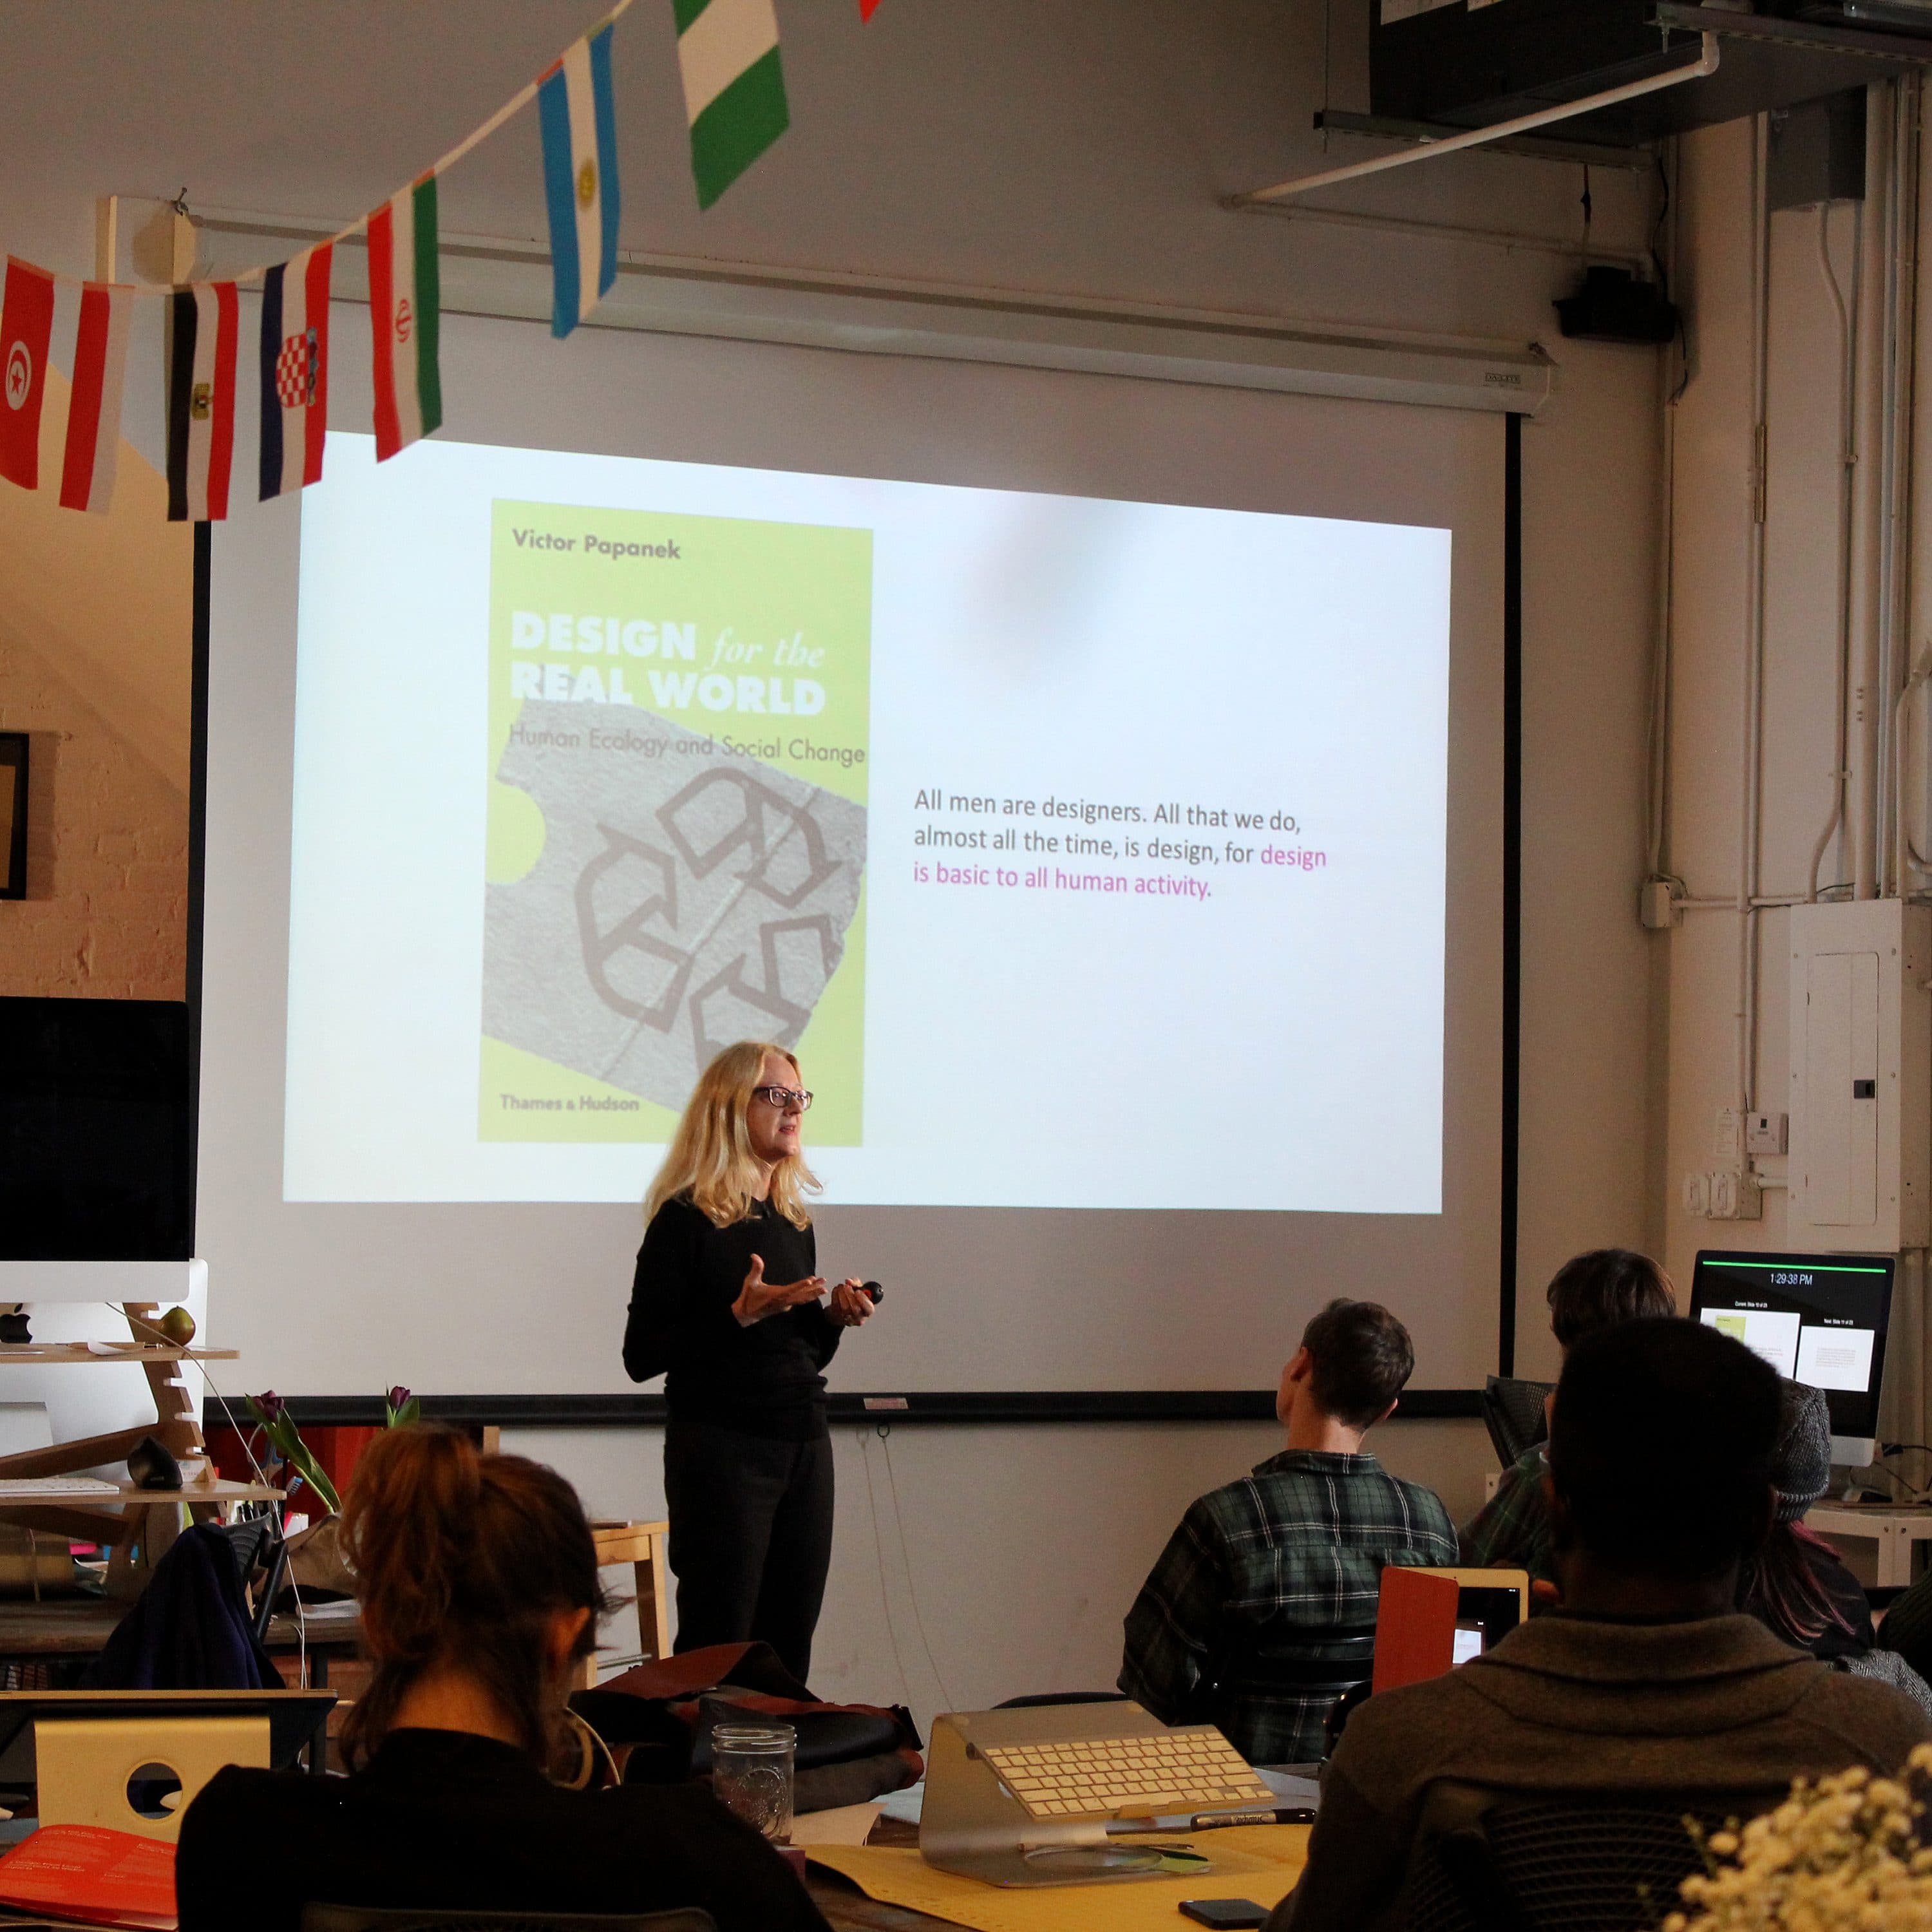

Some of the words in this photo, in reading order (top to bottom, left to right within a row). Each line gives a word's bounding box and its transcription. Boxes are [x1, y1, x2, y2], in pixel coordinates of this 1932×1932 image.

[513, 529, 576, 552] Victor
[585, 535, 681, 560] Papanek
[511, 611, 696, 661] DESIGN
[703, 626, 763, 671] for
[773, 632, 825, 667] the
[511, 661, 633, 705] REAL
[647, 671, 826, 715] WORLD
[509, 723, 580, 748] Human
[589, 728, 669, 757] Ecology
[676, 734, 713, 756] and
[723, 736, 781, 759] Social
[790, 739, 866, 768] Change
[914, 789, 942, 811] All
[949, 795, 996, 813] men
[1002, 798, 1036, 817] are
[1042, 796, 1147, 824] designers.
[1153, 803, 1179, 824] All
[1187, 804, 1228, 828] that
[1234, 813, 1264, 829] we
[1269, 810, 1301, 835] do,
[914, 824, 987, 849] almost
[992, 829, 1016, 850] all
[1023, 831, 1058, 853] the
[1065, 834, 1119, 860] time,
[1124, 837, 1140, 857] is
[1147, 837, 1219, 865] design,
[1224, 841, 1254, 863] for
[1260, 844, 1327, 871] design
[913, 862, 929, 883] is
[936, 862, 989, 886] basic
[996, 867, 1018, 887] to
[1025, 867, 1048, 888] all
[1055, 867, 1127, 893] human
[1134, 875, 1211, 902] activity.
[500, 1094, 562, 1110] Thames
[566, 1099, 575, 1111] &
[580, 1095, 640, 1112] Hudson
[1799, 1274, 1813, 1285] PM
